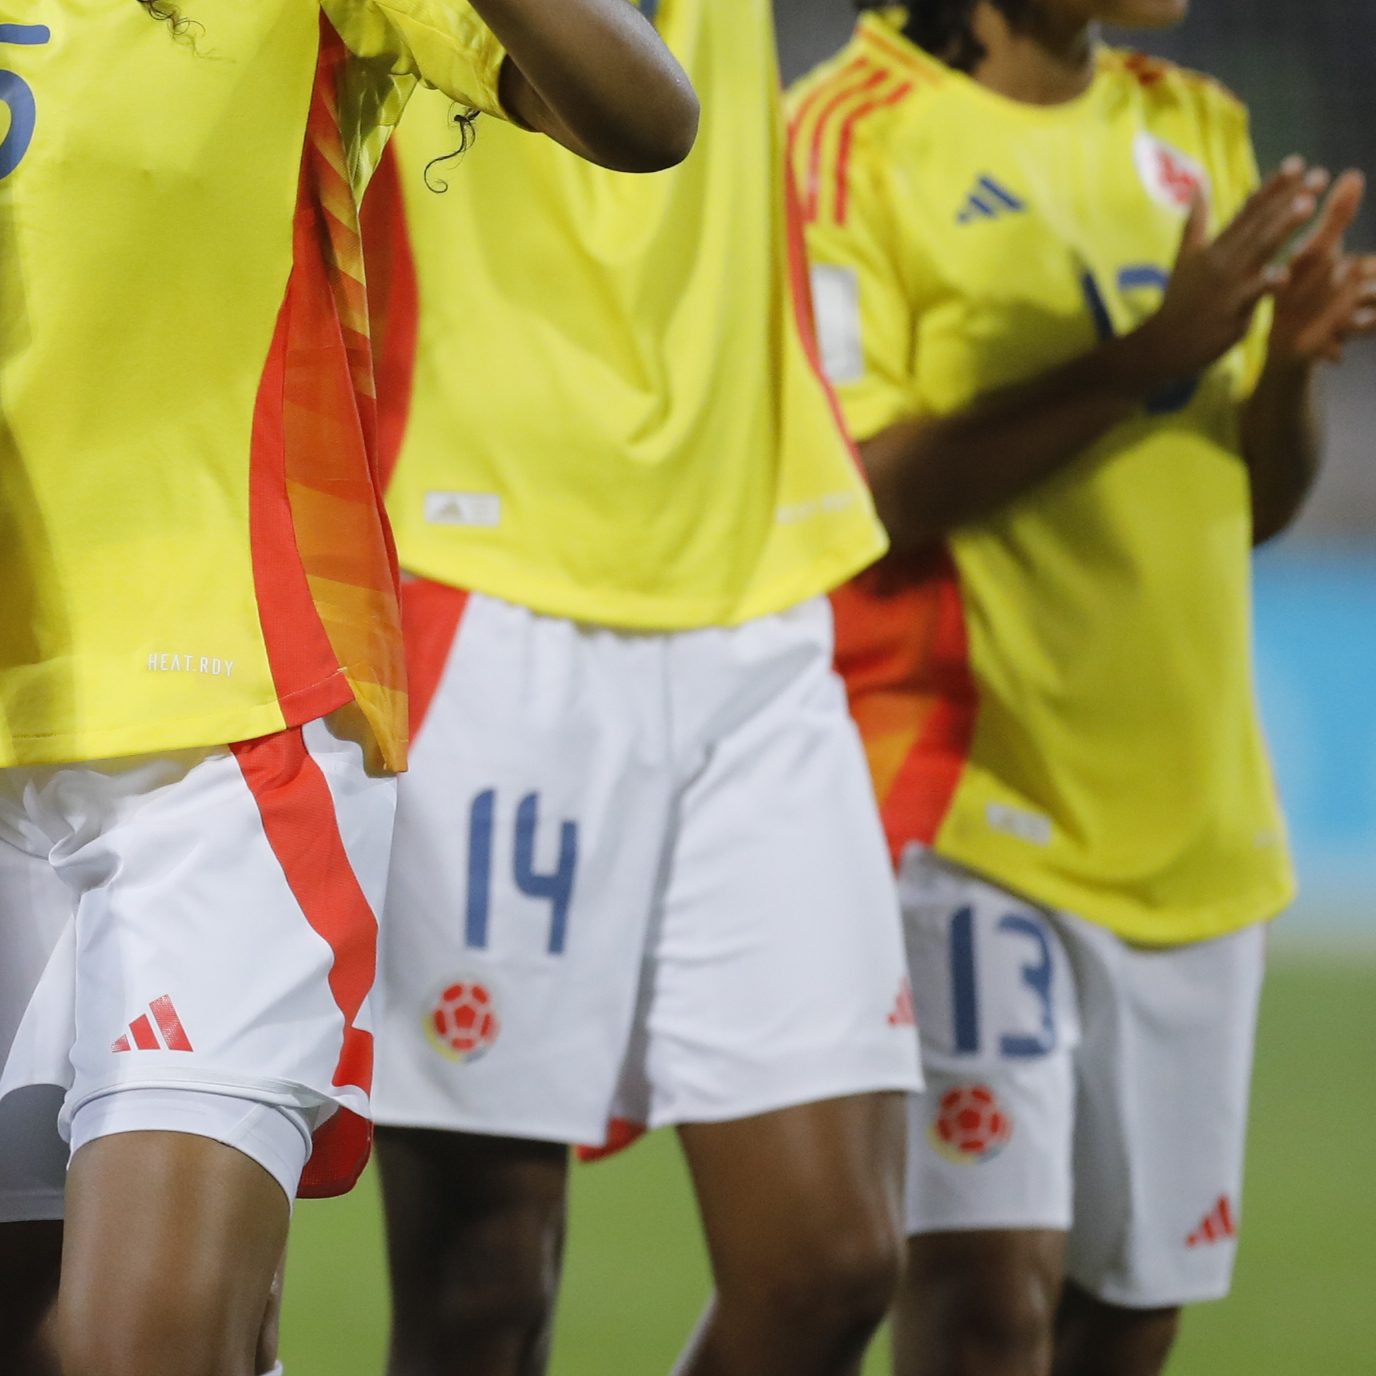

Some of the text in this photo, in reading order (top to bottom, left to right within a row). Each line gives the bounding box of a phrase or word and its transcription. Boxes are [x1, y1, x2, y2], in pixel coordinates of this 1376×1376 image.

[148, 653, 234, 678] HEAT.RDY
[465, 789, 579, 955] 14
[951, 905, 1055, 1057] 13
